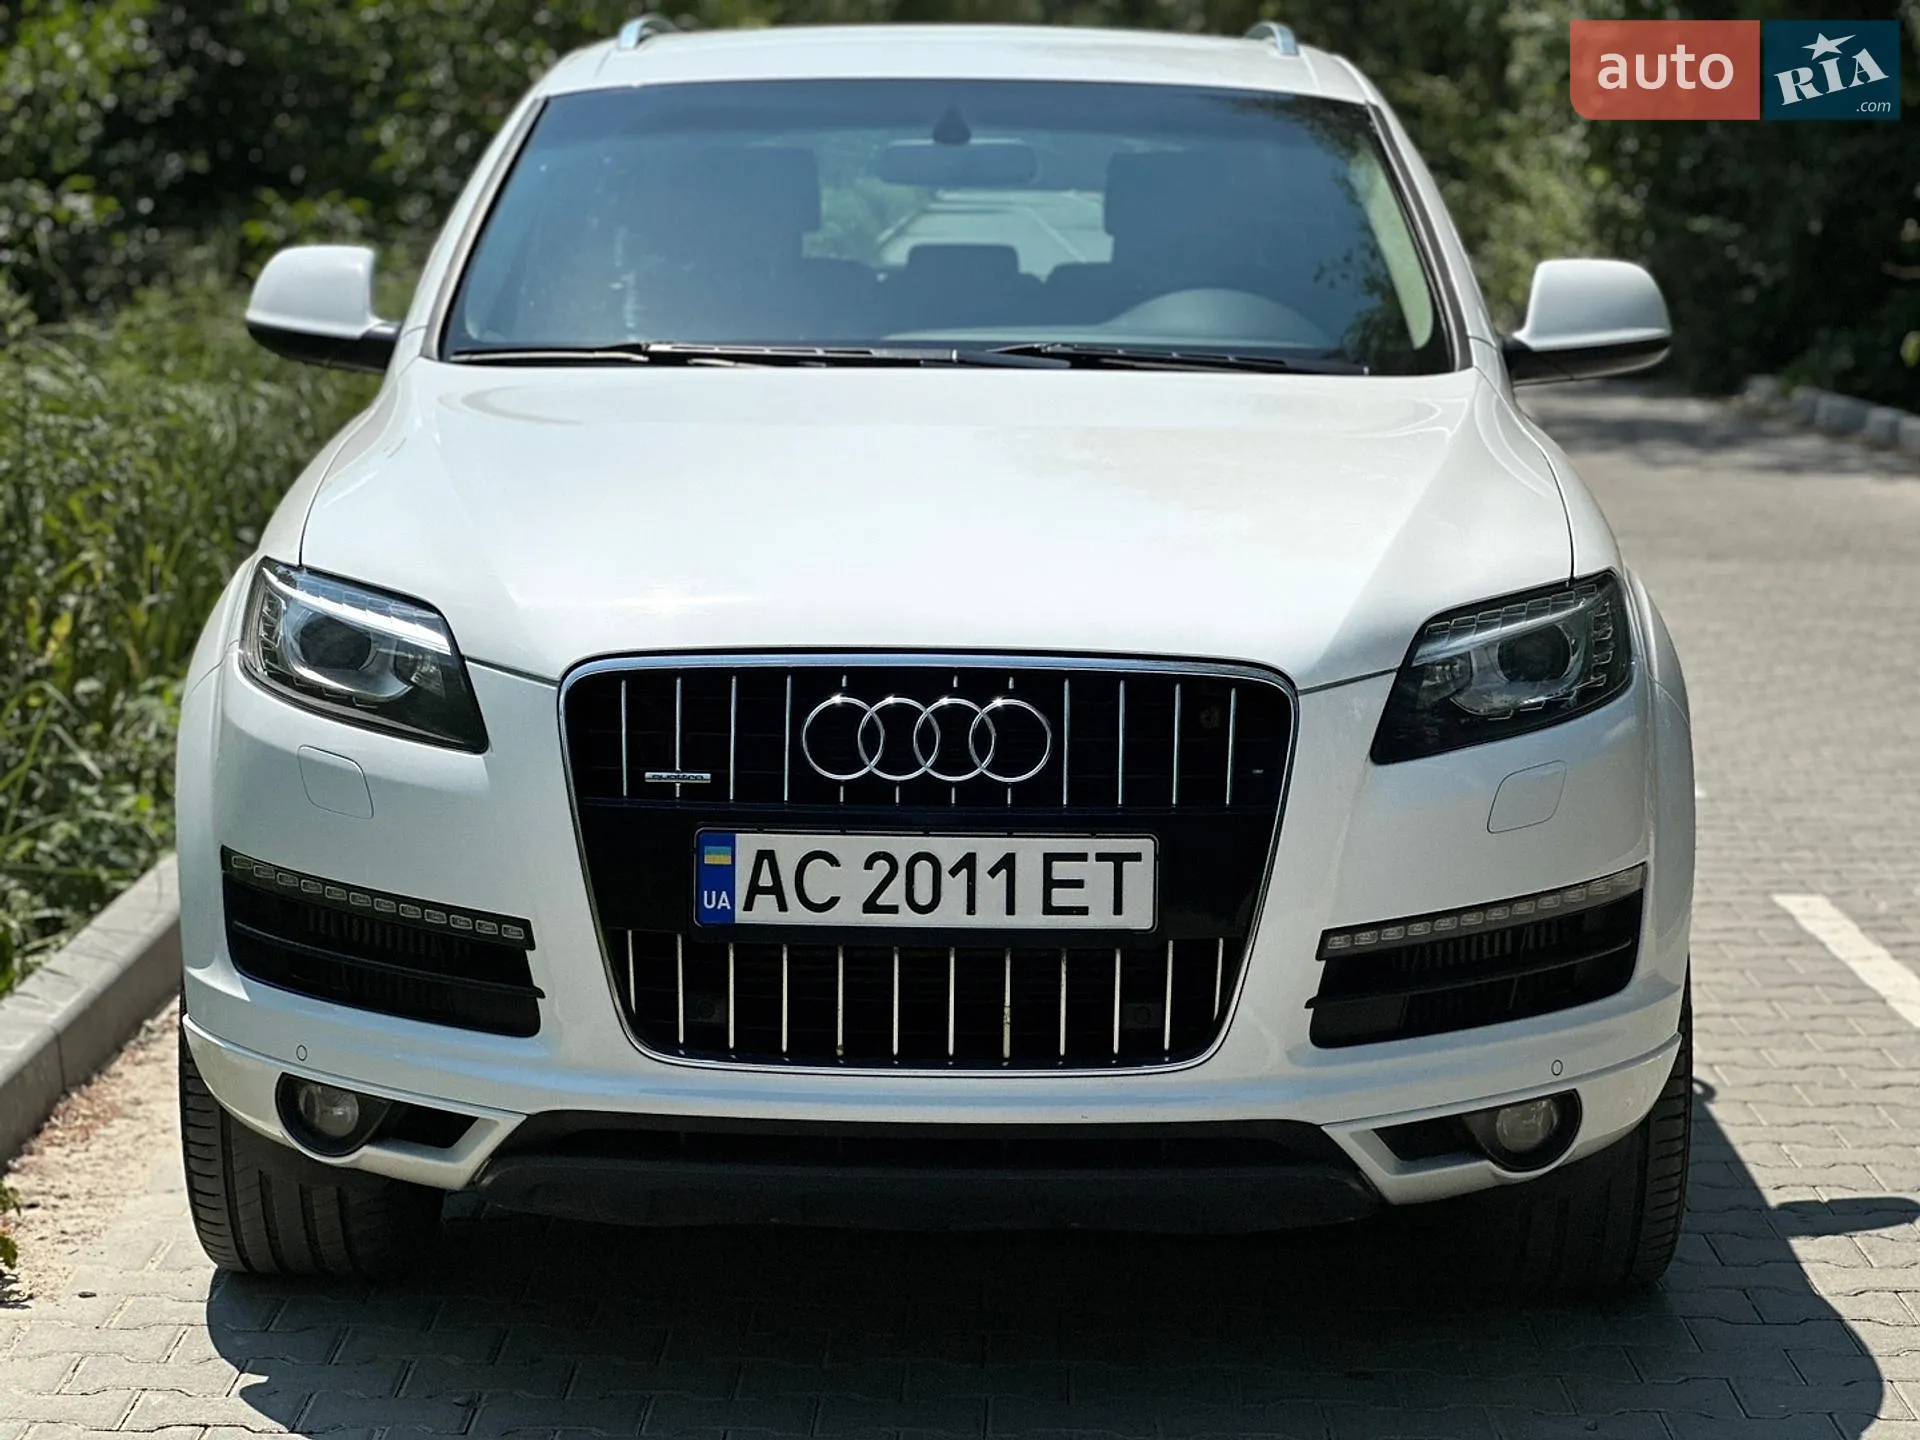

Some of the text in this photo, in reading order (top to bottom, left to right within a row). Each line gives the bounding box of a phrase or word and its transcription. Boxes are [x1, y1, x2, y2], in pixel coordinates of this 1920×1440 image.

[703, 890, 731, 910] UA
[742, 848, 1143, 916] AC 2011 ET
